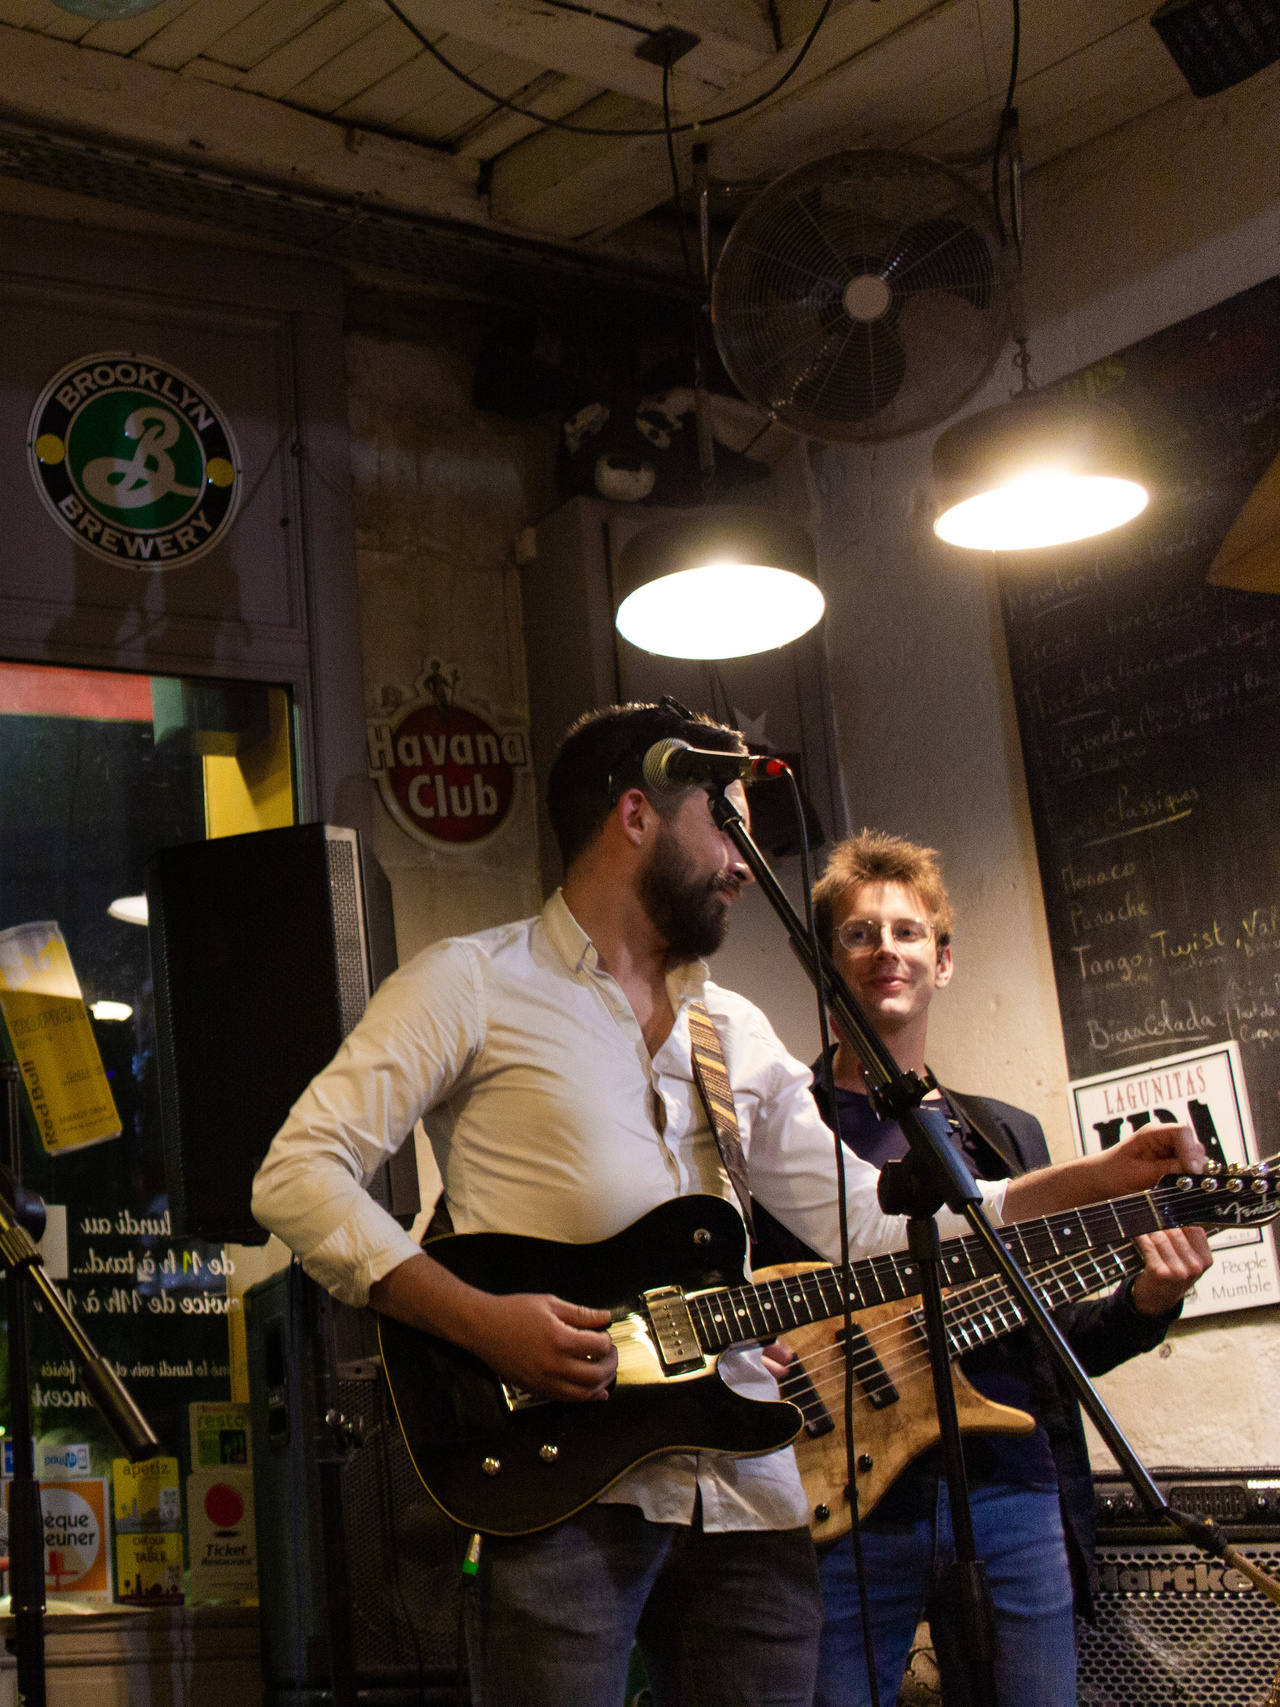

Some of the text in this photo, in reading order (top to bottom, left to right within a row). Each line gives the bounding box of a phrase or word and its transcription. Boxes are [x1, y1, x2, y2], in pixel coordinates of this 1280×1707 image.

[55, 363, 215, 432] BROOKLYN
[58, 493, 214, 559] BREWERY
[370, 725, 528, 768] Havana
[408, 773, 499, 818] Club
[1103, 1066, 1207, 1115] LAGUNITAS
[1221, 1251, 1268, 1280] People
[1211, 1275, 1273, 1300] Mumble
[122, 1460, 171, 1478] apetiz
[44, 1510, 89, 1529] èque
[44, 1531, 96, 1547] euner
[206, 1543, 248, 1556] Ticket
[134, 1552, 168, 1563] TABLE
